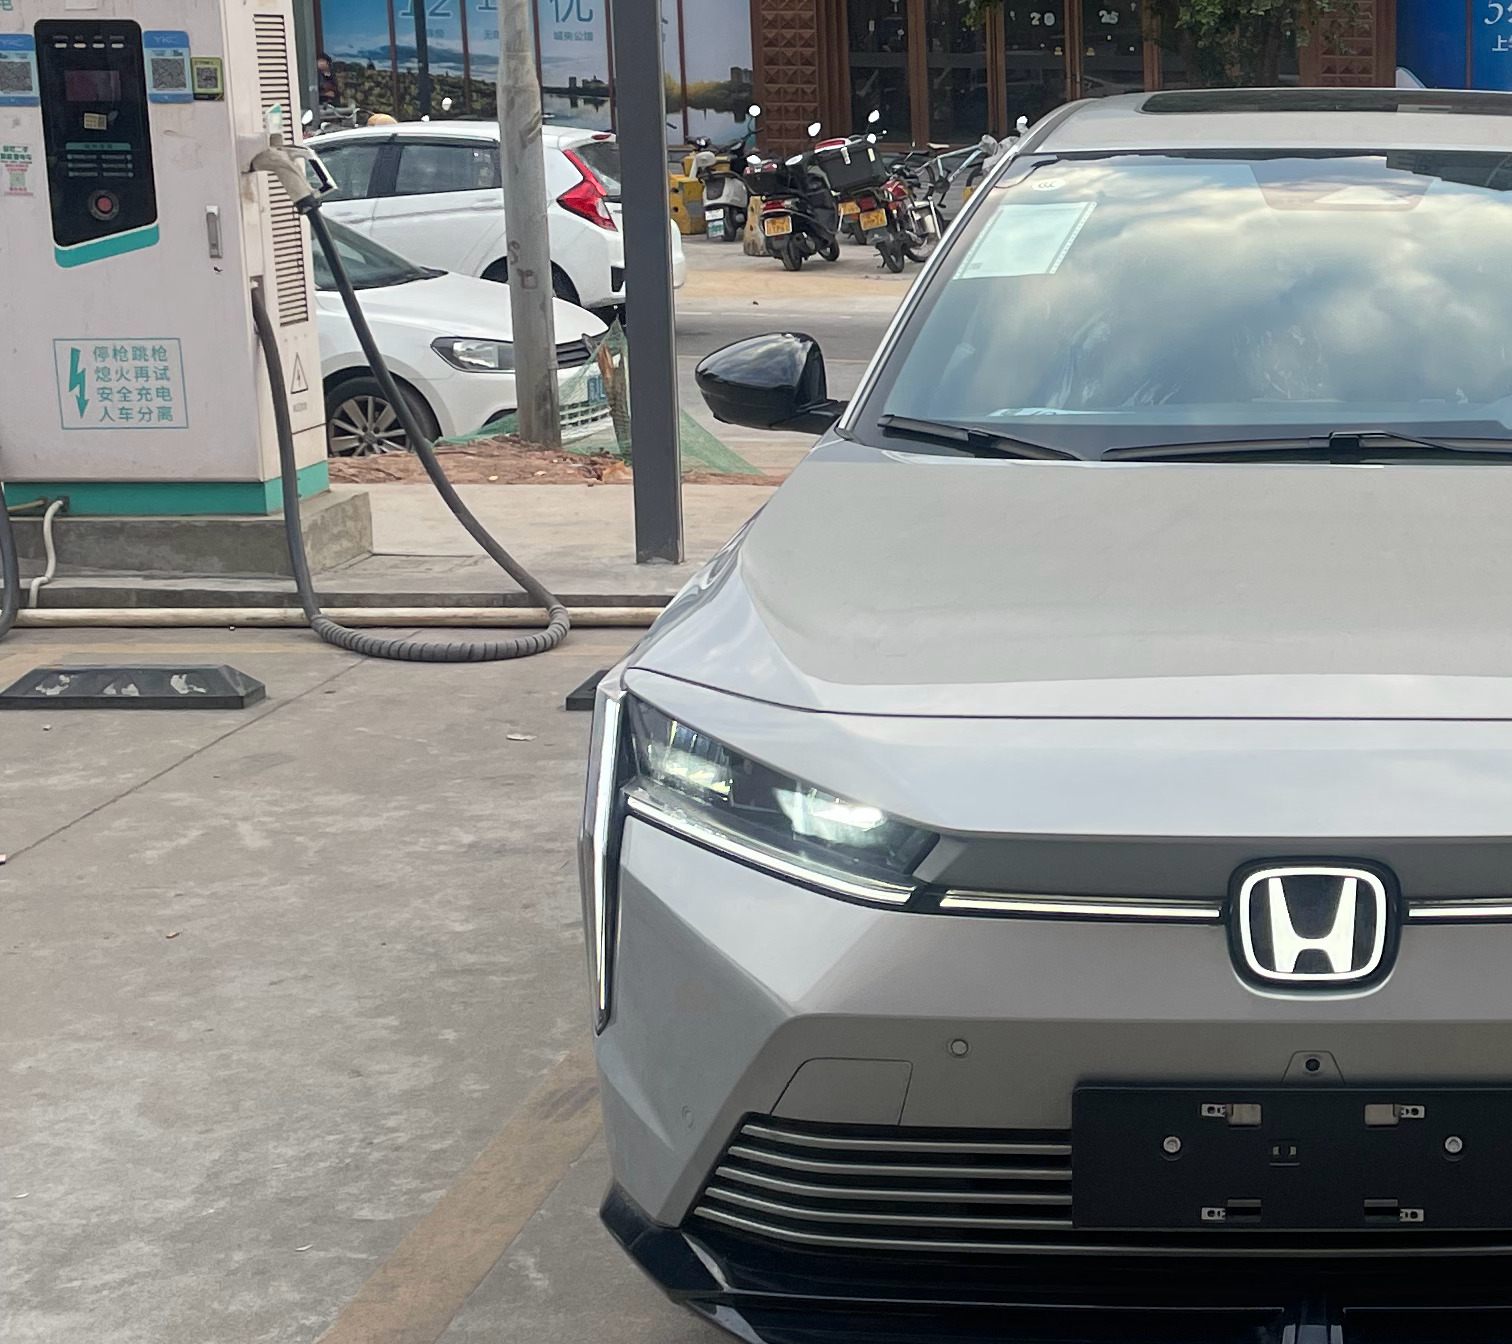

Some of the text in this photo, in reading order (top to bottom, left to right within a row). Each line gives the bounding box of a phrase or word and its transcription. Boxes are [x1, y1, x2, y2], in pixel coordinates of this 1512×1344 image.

[93, 345, 168, 363] 停枪跳枪
[94, 365, 170, 382] 熄火再试
[97, 386, 173, 403] 安全充电
[99, 406, 174, 423] 人车分离
